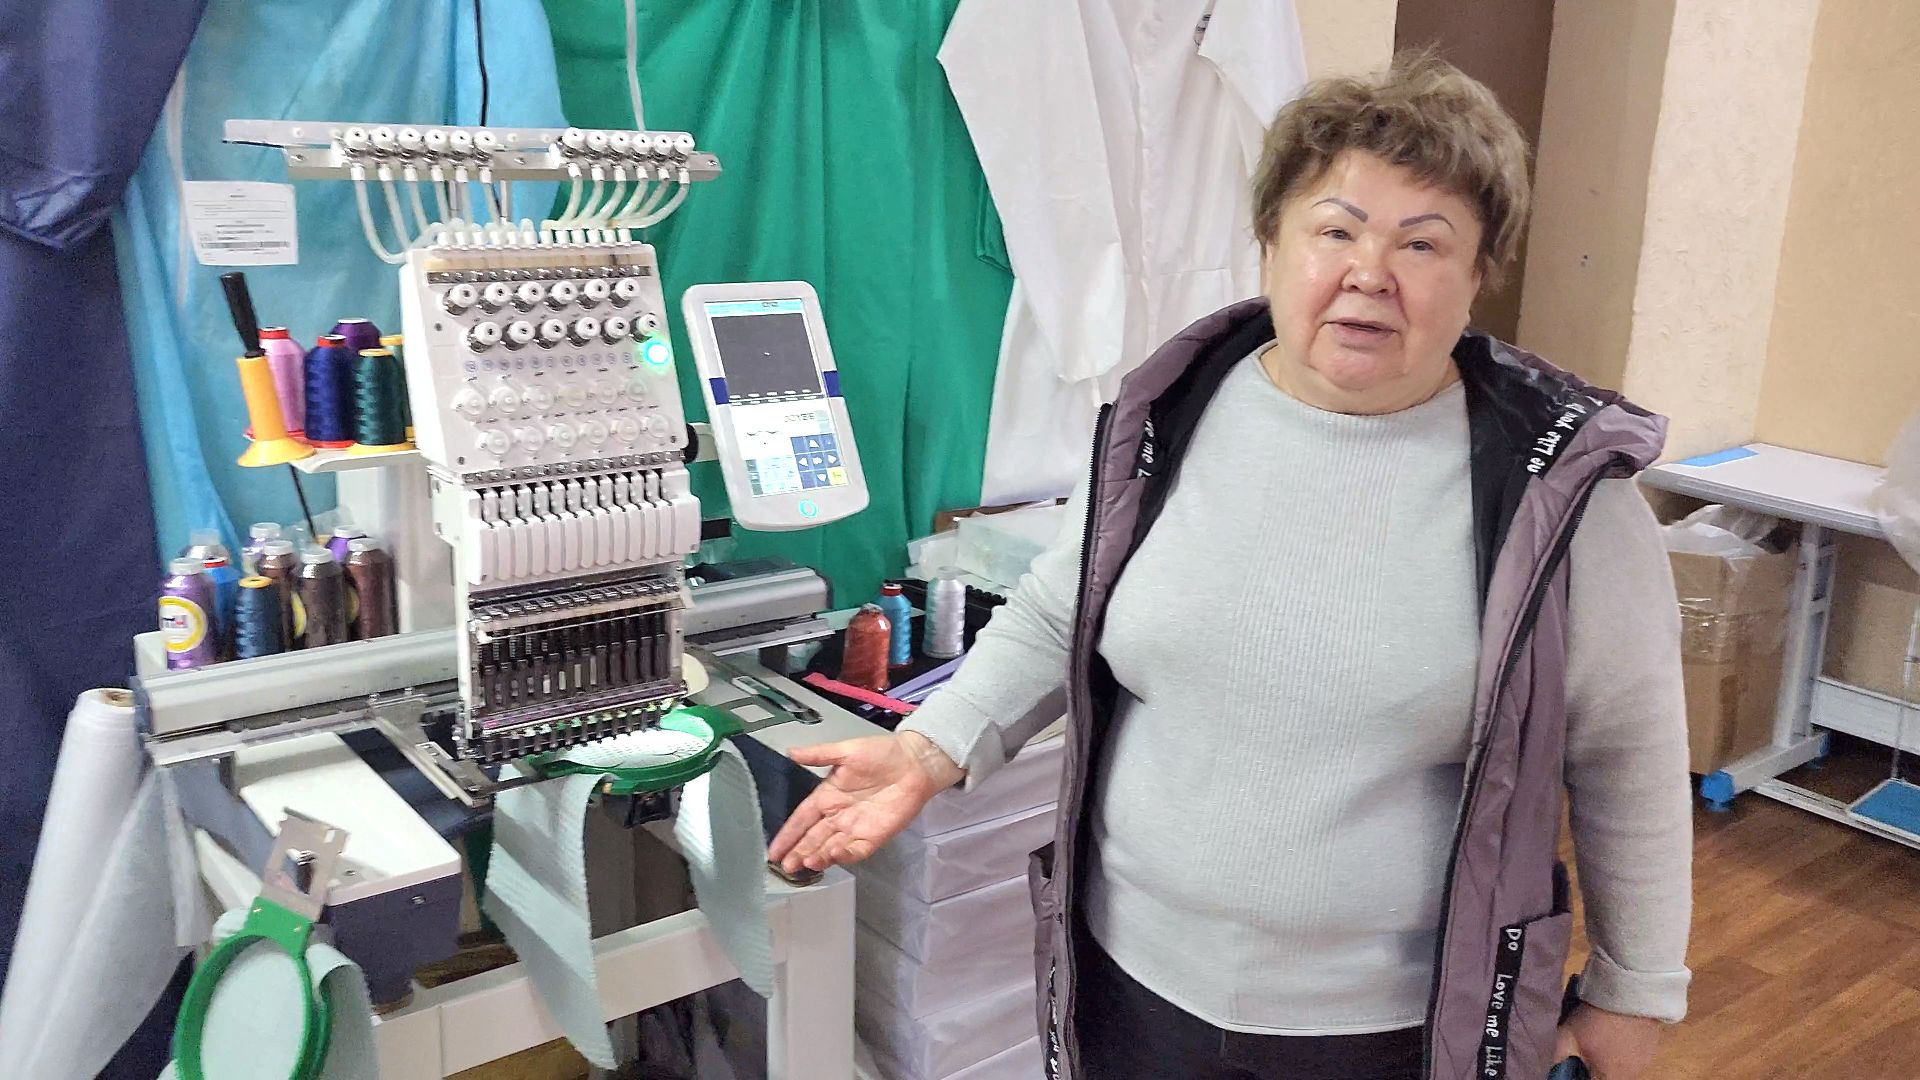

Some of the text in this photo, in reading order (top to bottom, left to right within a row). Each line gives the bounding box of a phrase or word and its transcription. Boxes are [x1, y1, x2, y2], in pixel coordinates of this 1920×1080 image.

[1532, 431, 1562, 456] Like
[1554, 412, 1580, 430] you
[1484, 928, 1523, 1077] Do Love me Like
